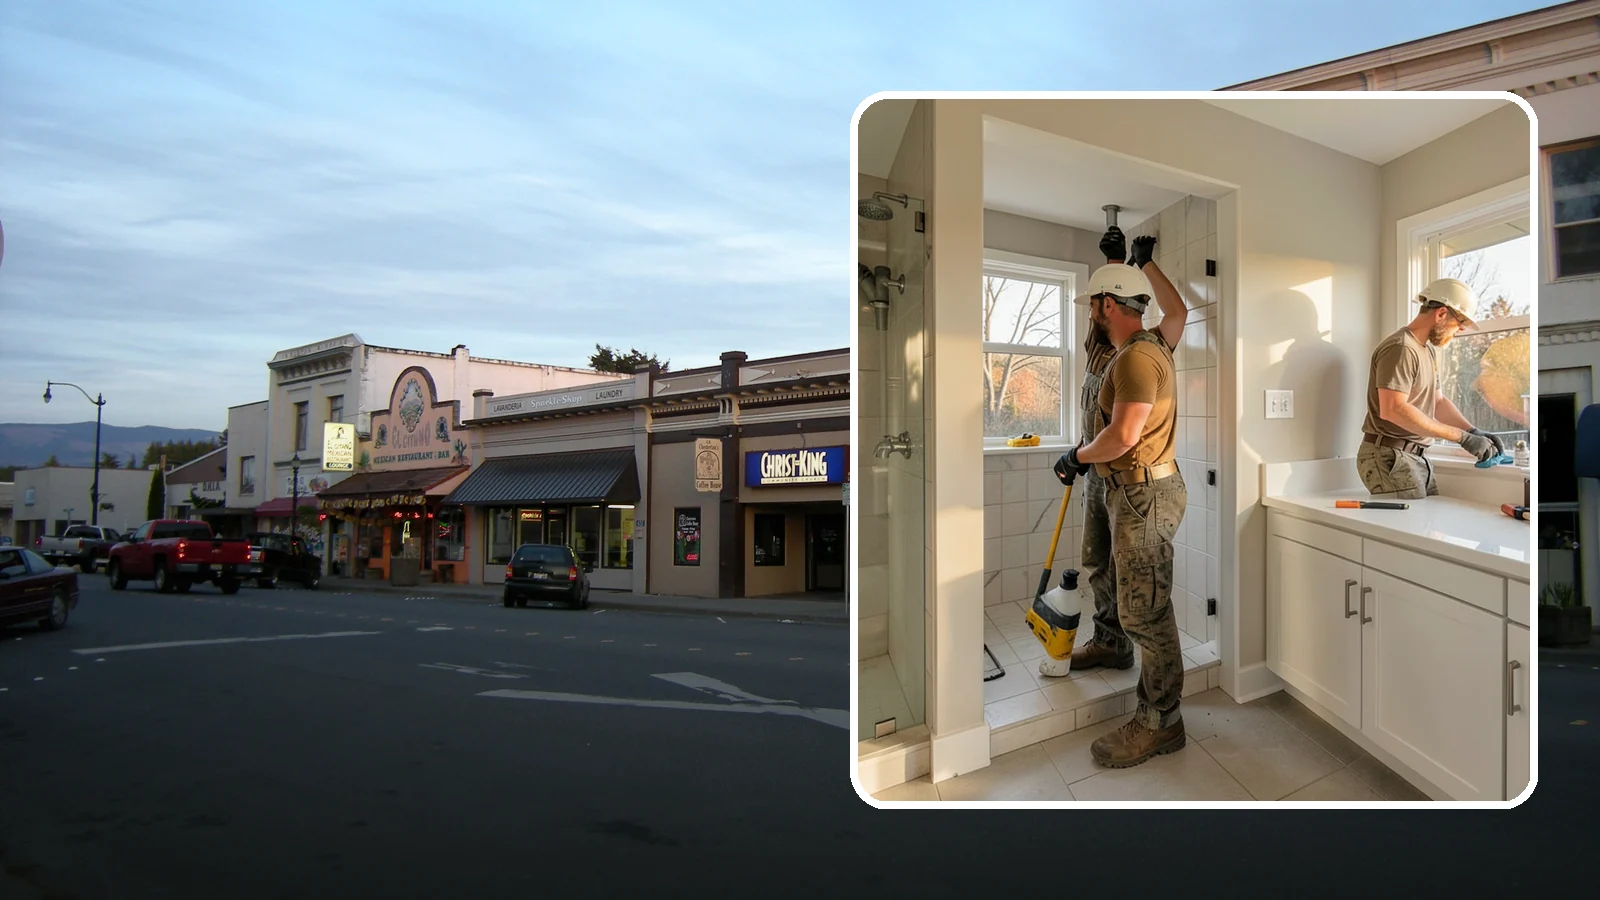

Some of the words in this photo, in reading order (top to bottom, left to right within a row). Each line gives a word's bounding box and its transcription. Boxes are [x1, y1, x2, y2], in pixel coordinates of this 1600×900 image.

[596, 389, 623, 399] LAUNDRY
[562, 394, 582, 405] Shop
[493, 402, 522, 412] LAVANDERIA
[373, 455, 396, 464] MEXICAN
[397, 451, 434, 463] RESTAURANT
[437, 450, 450, 459] BAR
[761, 452, 797, 478] CHRIST
[799, 450, 828, 477] KING
[696, 480, 709, 489] Coffee
[710, 480, 722, 489] House
